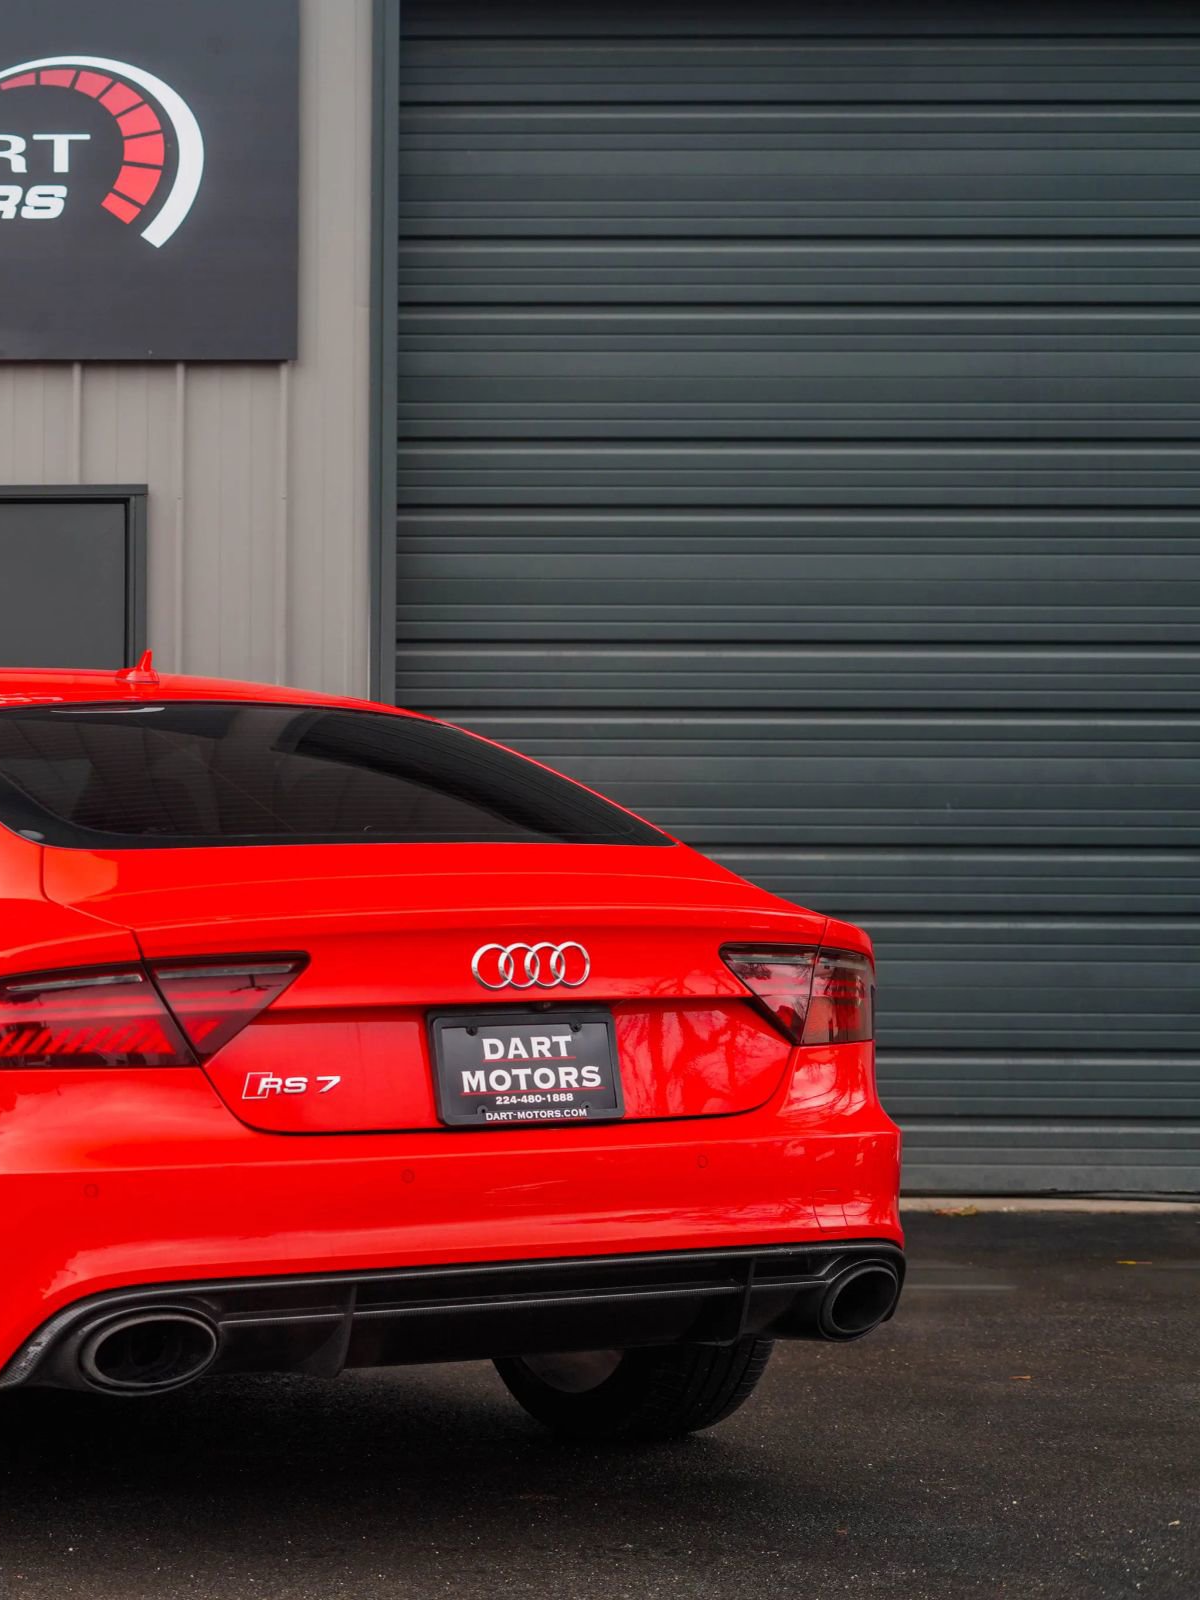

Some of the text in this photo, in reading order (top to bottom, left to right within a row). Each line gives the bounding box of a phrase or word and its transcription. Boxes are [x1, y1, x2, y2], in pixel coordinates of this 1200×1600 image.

[481, 1034, 572, 1061] DART
[257, 1075, 341, 1095] RS 7
[461, 1065, 602, 1093] MOTORS
[495, 1092, 574, 1105] 224-480-1888
[485, 1108, 588, 1121] DART-MOTORS.COM
